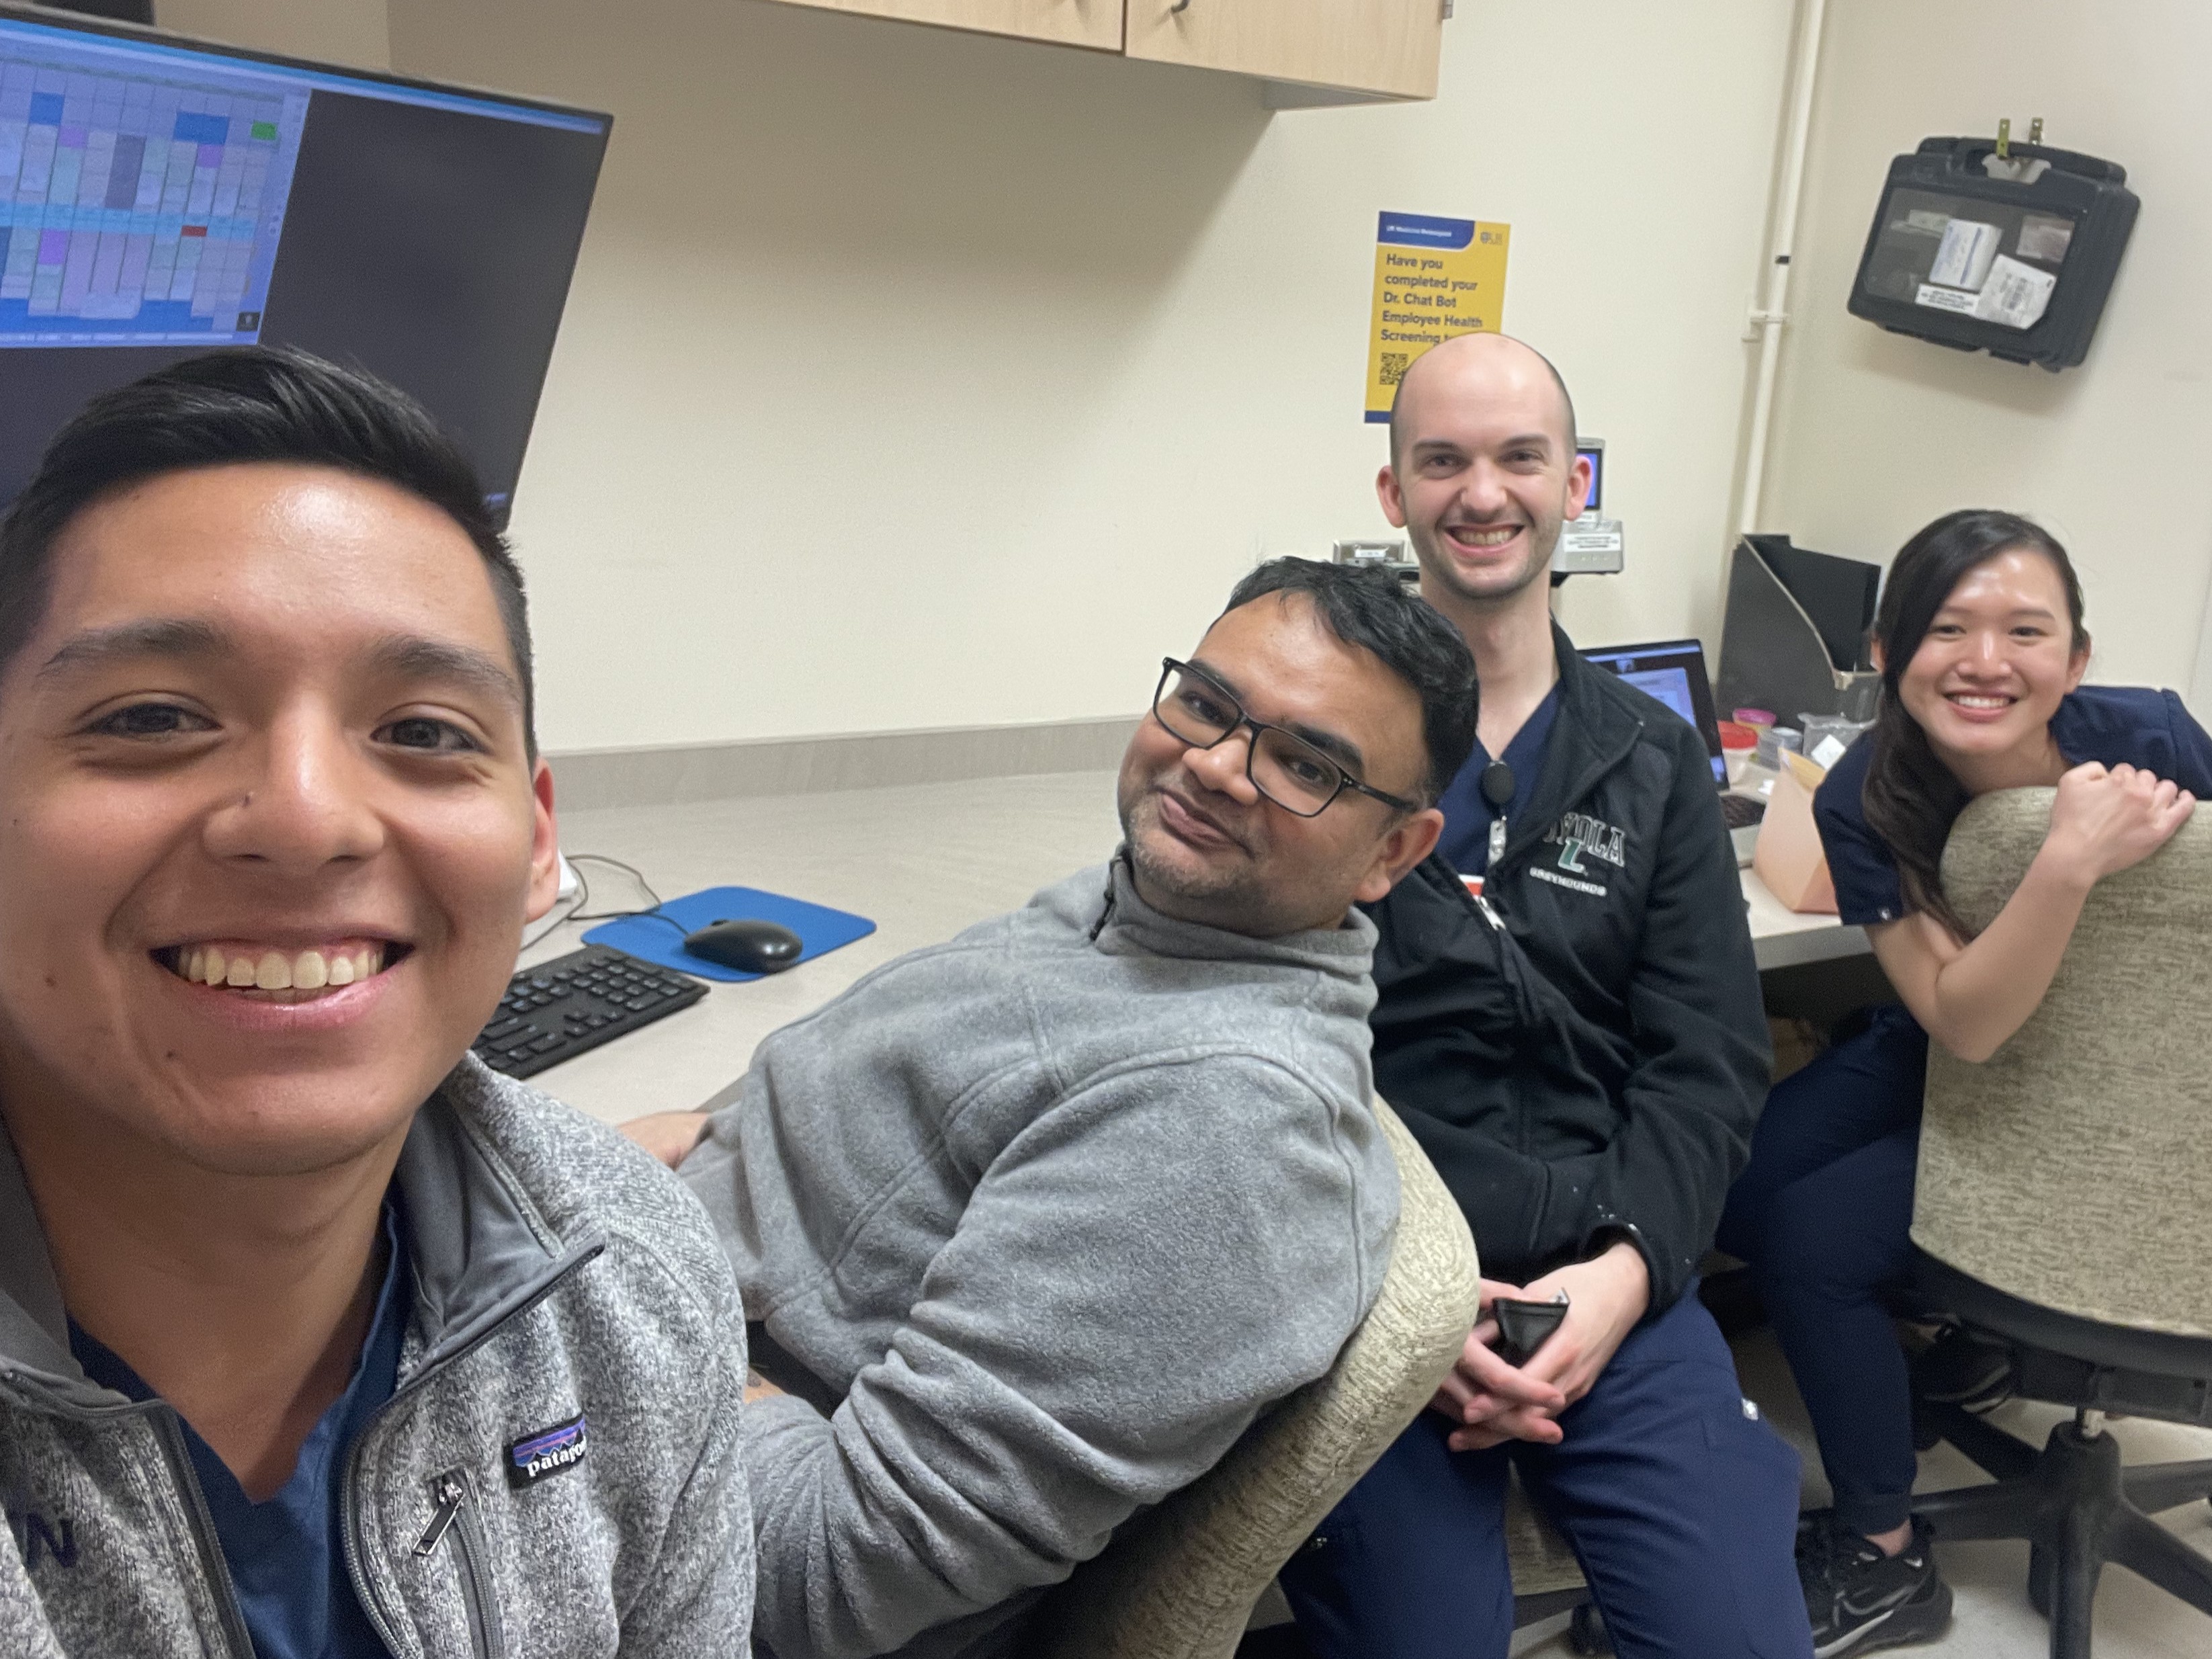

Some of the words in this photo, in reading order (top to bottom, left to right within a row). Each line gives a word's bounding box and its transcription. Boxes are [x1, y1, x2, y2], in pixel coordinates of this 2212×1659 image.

[1386, 253, 1417, 267] Have
[1420, 259, 1443, 270] you
[1384, 274, 1449, 289] completed
[1451, 280, 1478, 292] your
[1383, 290, 1400, 304] Dr.
[1404, 292, 1433, 306] Chat
[1436, 295, 1457, 308] Bot
[1382, 310, 1441, 327] Employee
[1444, 314, 1483, 328] Health
[1380, 329, 1441, 345] Screening
